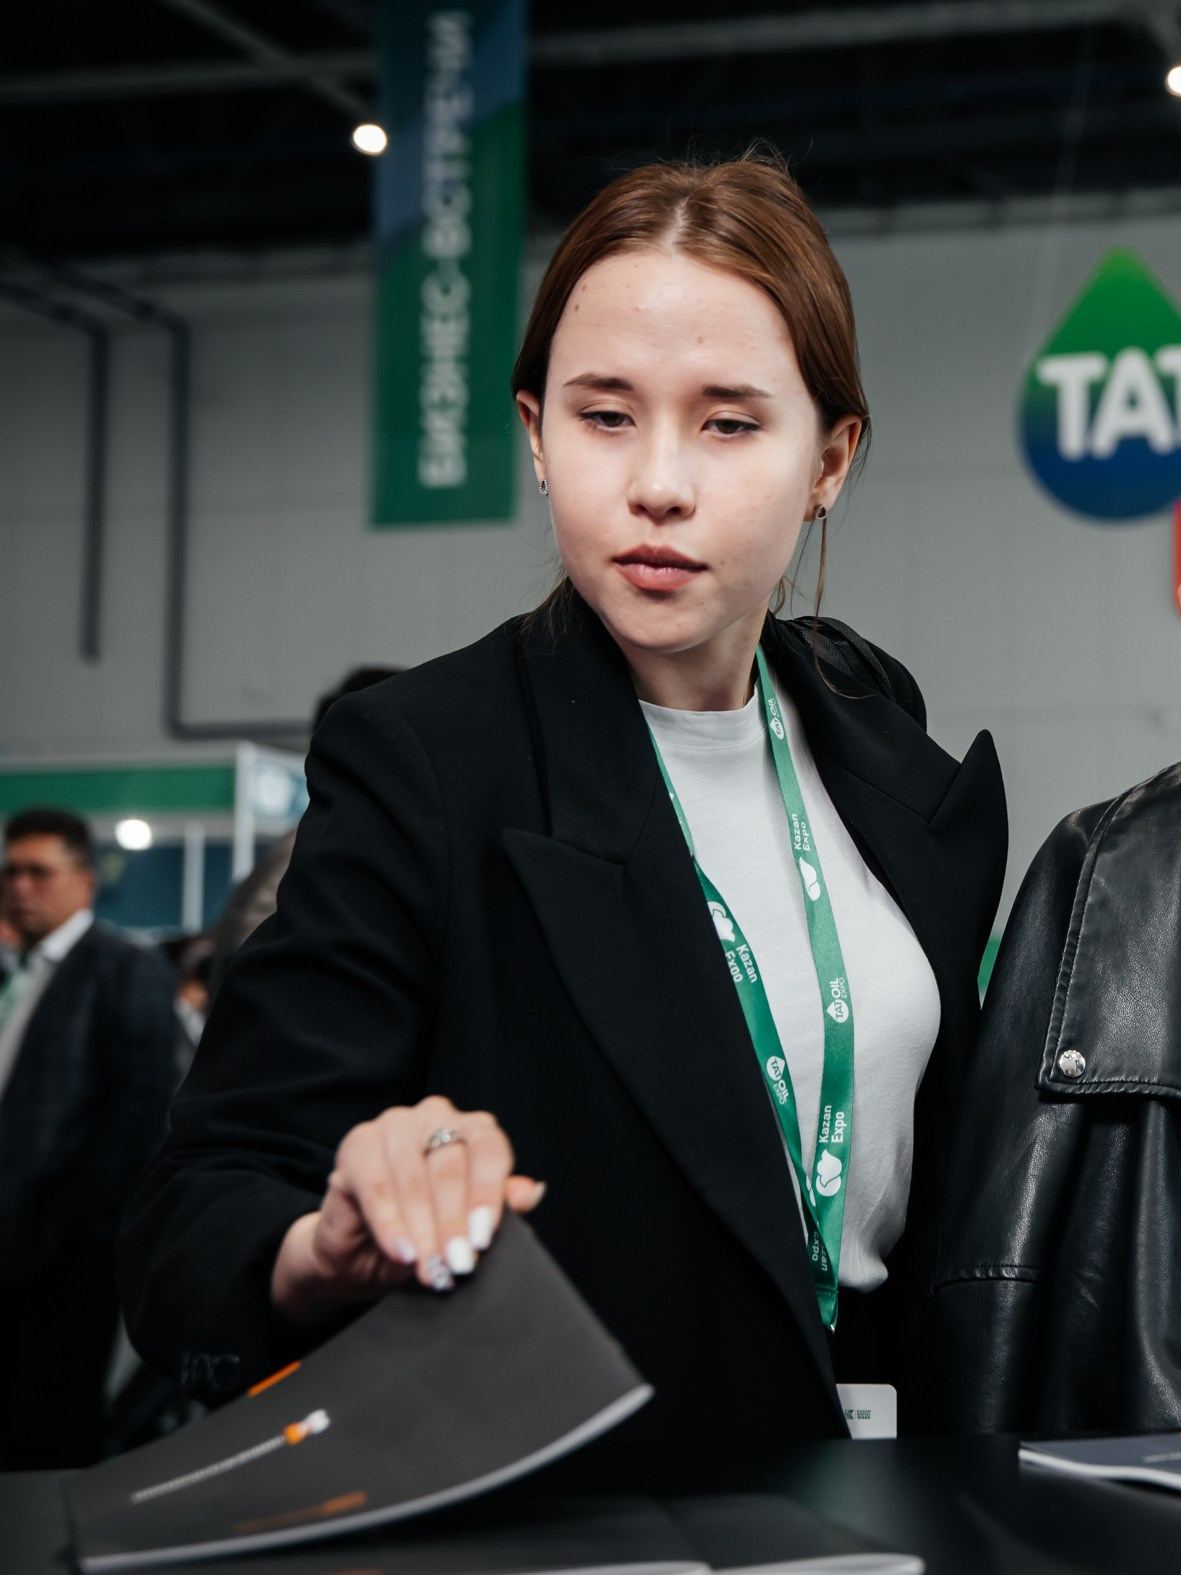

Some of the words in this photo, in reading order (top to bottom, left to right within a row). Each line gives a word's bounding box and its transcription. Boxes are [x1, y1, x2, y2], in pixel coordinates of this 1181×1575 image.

[791, 813, 802, 850] Kazan
[801, 821, 810, 851] Expo
[736, 944, 757, 983] Kazan
[830, 977, 840, 999] OIL
[834, 1001, 844, 1020] TAT
[771, 1058, 781, 1078] TAT
[778, 1079, 789, 1102] OIL
[818, 1104, 832, 1143] Kazan
[831, 1111, 848, 1143] Expo
